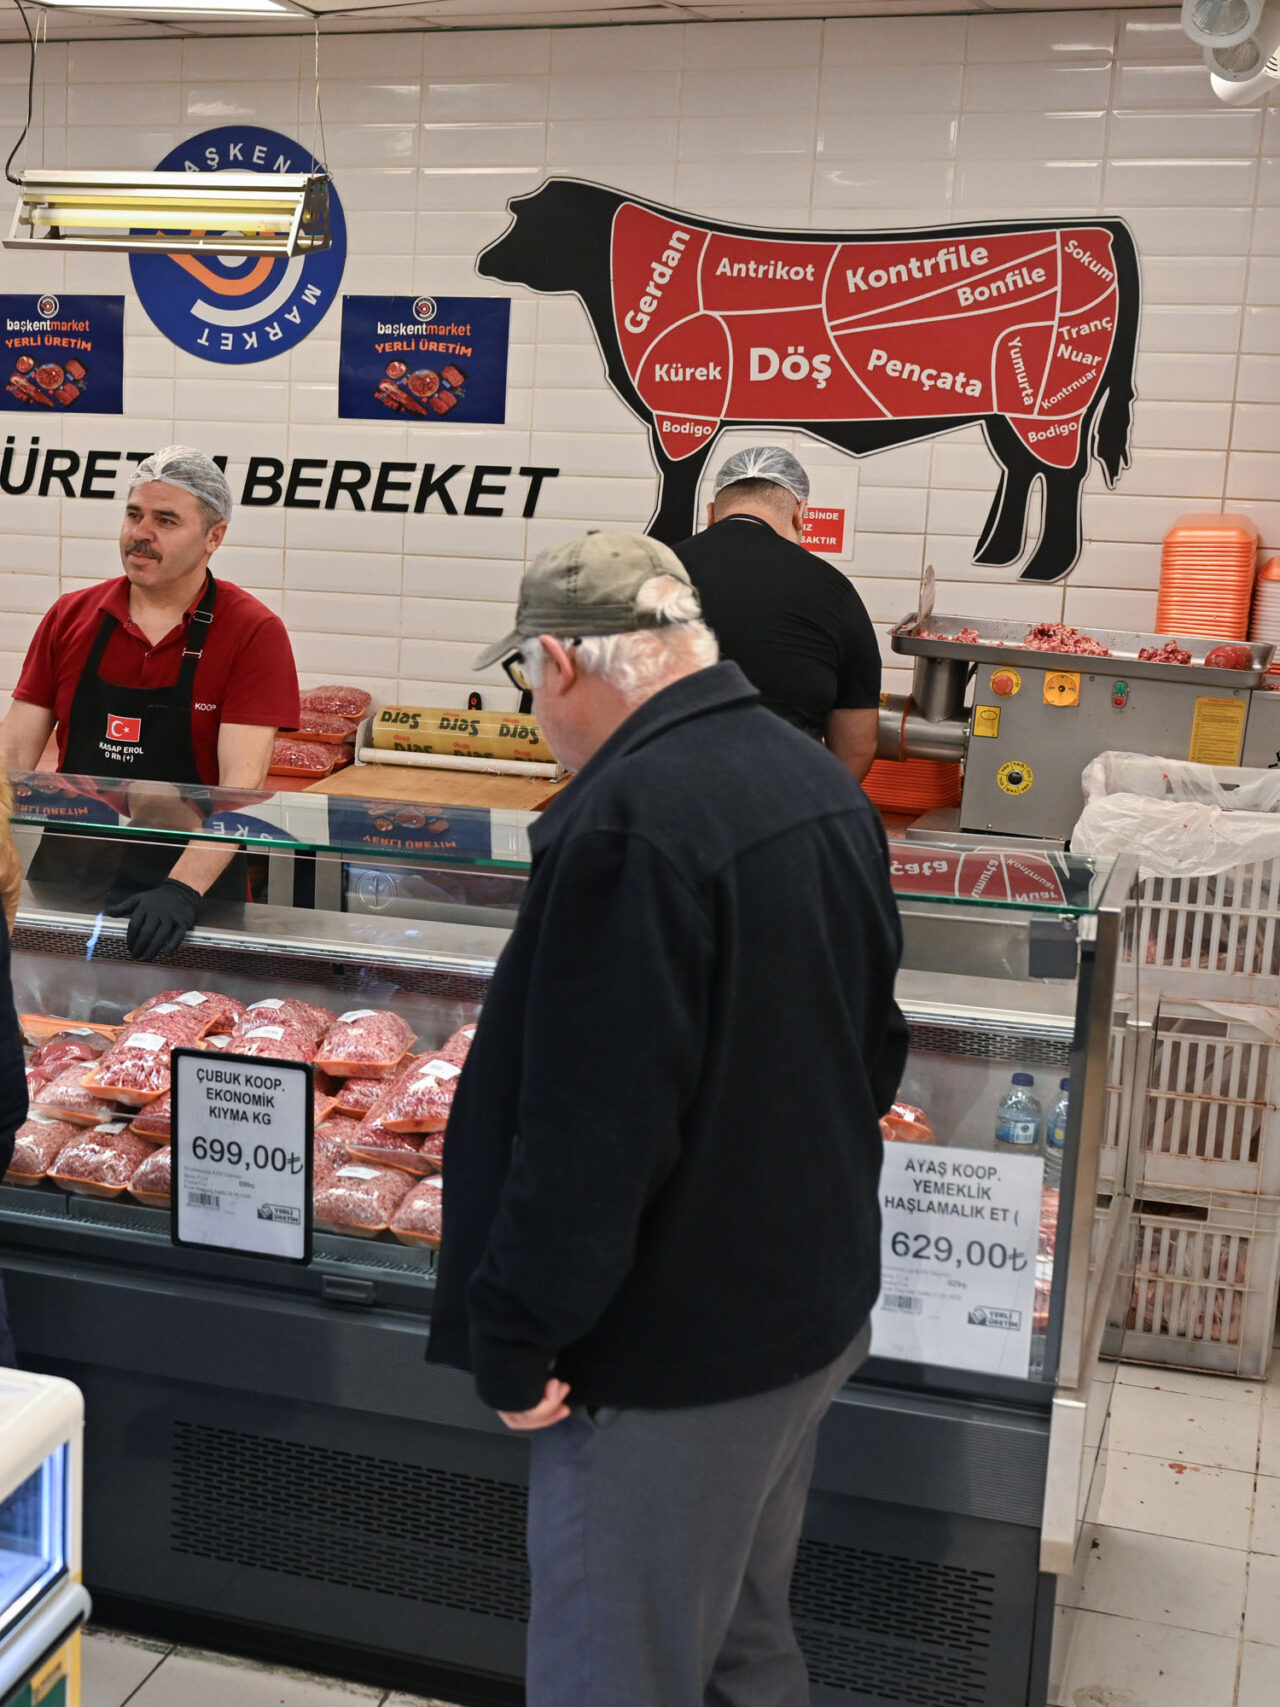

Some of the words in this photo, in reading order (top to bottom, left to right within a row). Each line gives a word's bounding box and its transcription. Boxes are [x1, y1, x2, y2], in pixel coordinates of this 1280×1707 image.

[184, 143, 304, 174] AŞKEN
[715, 257, 816, 282] Antrikot
[845, 244, 989, 293] Kontrfile
[1064, 239, 1114, 283] Sokum
[624, 229, 691, 334] Gerdan
[956, 266, 1047, 307] Bonfile
[6, 318, 90, 333] başkentmarket
[197, 284, 322, 350] MARKET
[1058, 316, 1113, 341] Tranç
[377, 321, 471, 337] başkentmarket
[5, 334, 41, 349] YERLİ
[44, 334, 92, 352] ÜRETİM
[374, 338, 416, 354] YERLİ
[419, 338, 472, 357] ÜRETİM
[1056, 343, 1102, 367] Nuar
[654, 362, 722, 382] Kürek
[749, 345, 832, 389] Döş
[866, 348, 983, 398] Pençata
[1008, 336, 1035, 406] Yumurta
[1041, 368, 1098, 410] Kontrnuar
[662, 420, 713, 437] Bodigo
[1027, 421, 1078, 443] Bodigo
[241, 456, 560, 518] BEREKET
[803, 510, 839, 520] ESİNDE
[800, 536, 837, 545] SAKTIR
[194, 702, 217, 711] KOOP
[380, 711, 422, 729] Sera
[439, 717, 480, 736] Sera
[498, 723, 540, 744] Sera
[98, 741, 122, 752] KASAP
[123, 746, 144, 754] EROL
[111, 752, 121, 760] Rh
[196, 1068, 241, 1086] ÇUBUK
[245, 1074, 286, 1092] KOOP.
[206, 1087, 275, 1108] EKONOMİK
[209, 1106, 249, 1123] KIYMA
[252, 1112, 272, 1125] KG
[192, 1136, 304, 1175] 699,00₺
[905, 1158, 948, 1177] AYAŞ
[952, 1163, 1001, 1181] KOOP.
[913, 1179, 992, 1200] YEMEKLİK
[884, 1196, 985, 1220] HAŞLAMALIK
[990, 1207, 1010, 1221] ET
[891, 1231, 1028, 1272] 629,00₺
